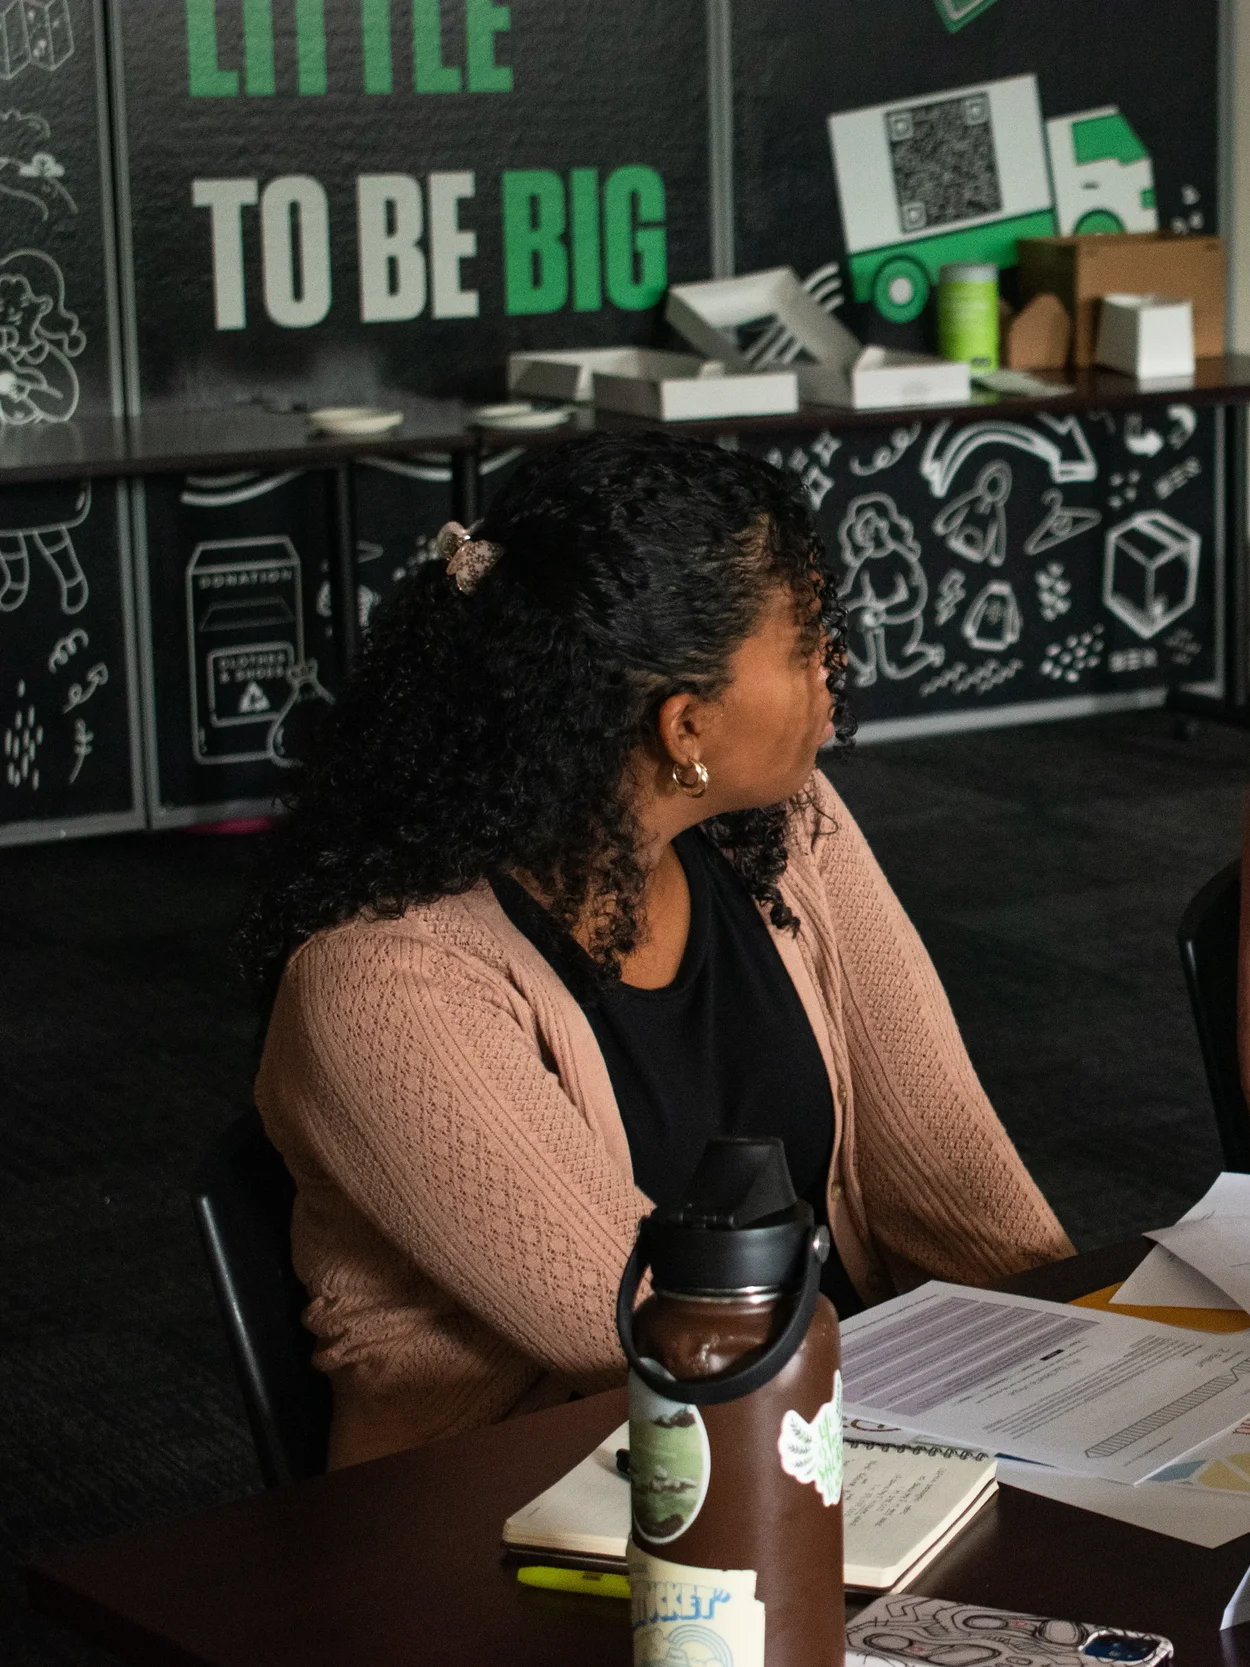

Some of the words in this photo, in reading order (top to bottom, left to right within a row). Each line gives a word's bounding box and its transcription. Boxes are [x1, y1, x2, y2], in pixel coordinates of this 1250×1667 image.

[192, 175, 332, 331] TO
[356, 170, 480, 323] BE
[502, 164, 668, 316] BIG
